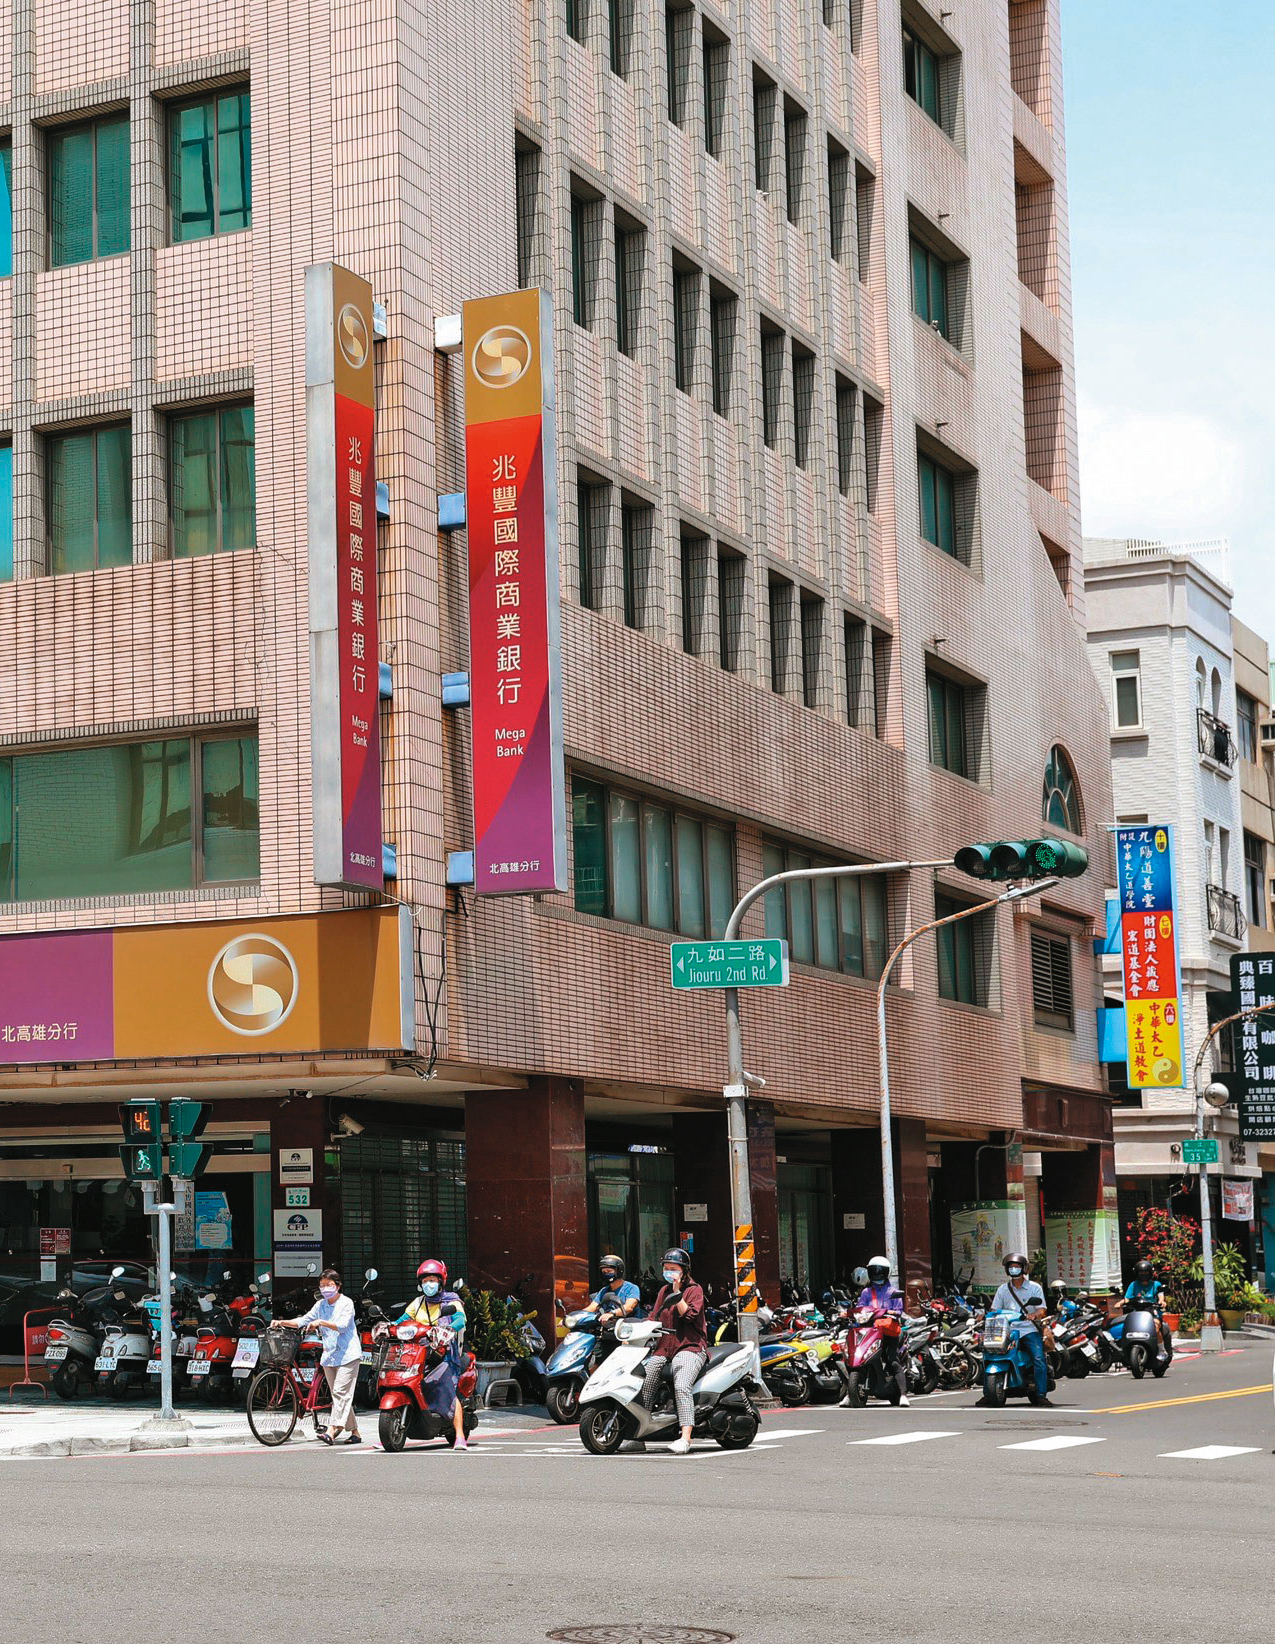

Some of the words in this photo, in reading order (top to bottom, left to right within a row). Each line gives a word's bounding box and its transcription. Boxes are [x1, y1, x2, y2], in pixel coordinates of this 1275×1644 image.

[347, 435, 366, 695] 兆豐國際商業銀行
[491, 454, 523, 706] 兆豐國際商業銀行
[351, 714, 369, 732] Mega
[352, 734, 368, 747] Bank
[494, 727, 526, 744] Mega
[496, 744, 524, 757] Bank
[349, 851, 376, 868] 北高雄分行
[489, 860, 540, 875] 北高雄分行
[1138, 831, 1155, 908] 九陽道善堂
[687, 945, 766, 964] 九如二路
[688, 967, 721, 983] Jiouru
[726, 966, 746, 982] 2nd
[751, 965, 768, 980] Rd.
[1, 1022, 77, 1043] 北高雄分行
[1149, 1002, 1164, 1058] 中華太乙
[1133, 1013, 1149, 1082] 淨土道教會
[288, 1194, 308, 1204] 532
